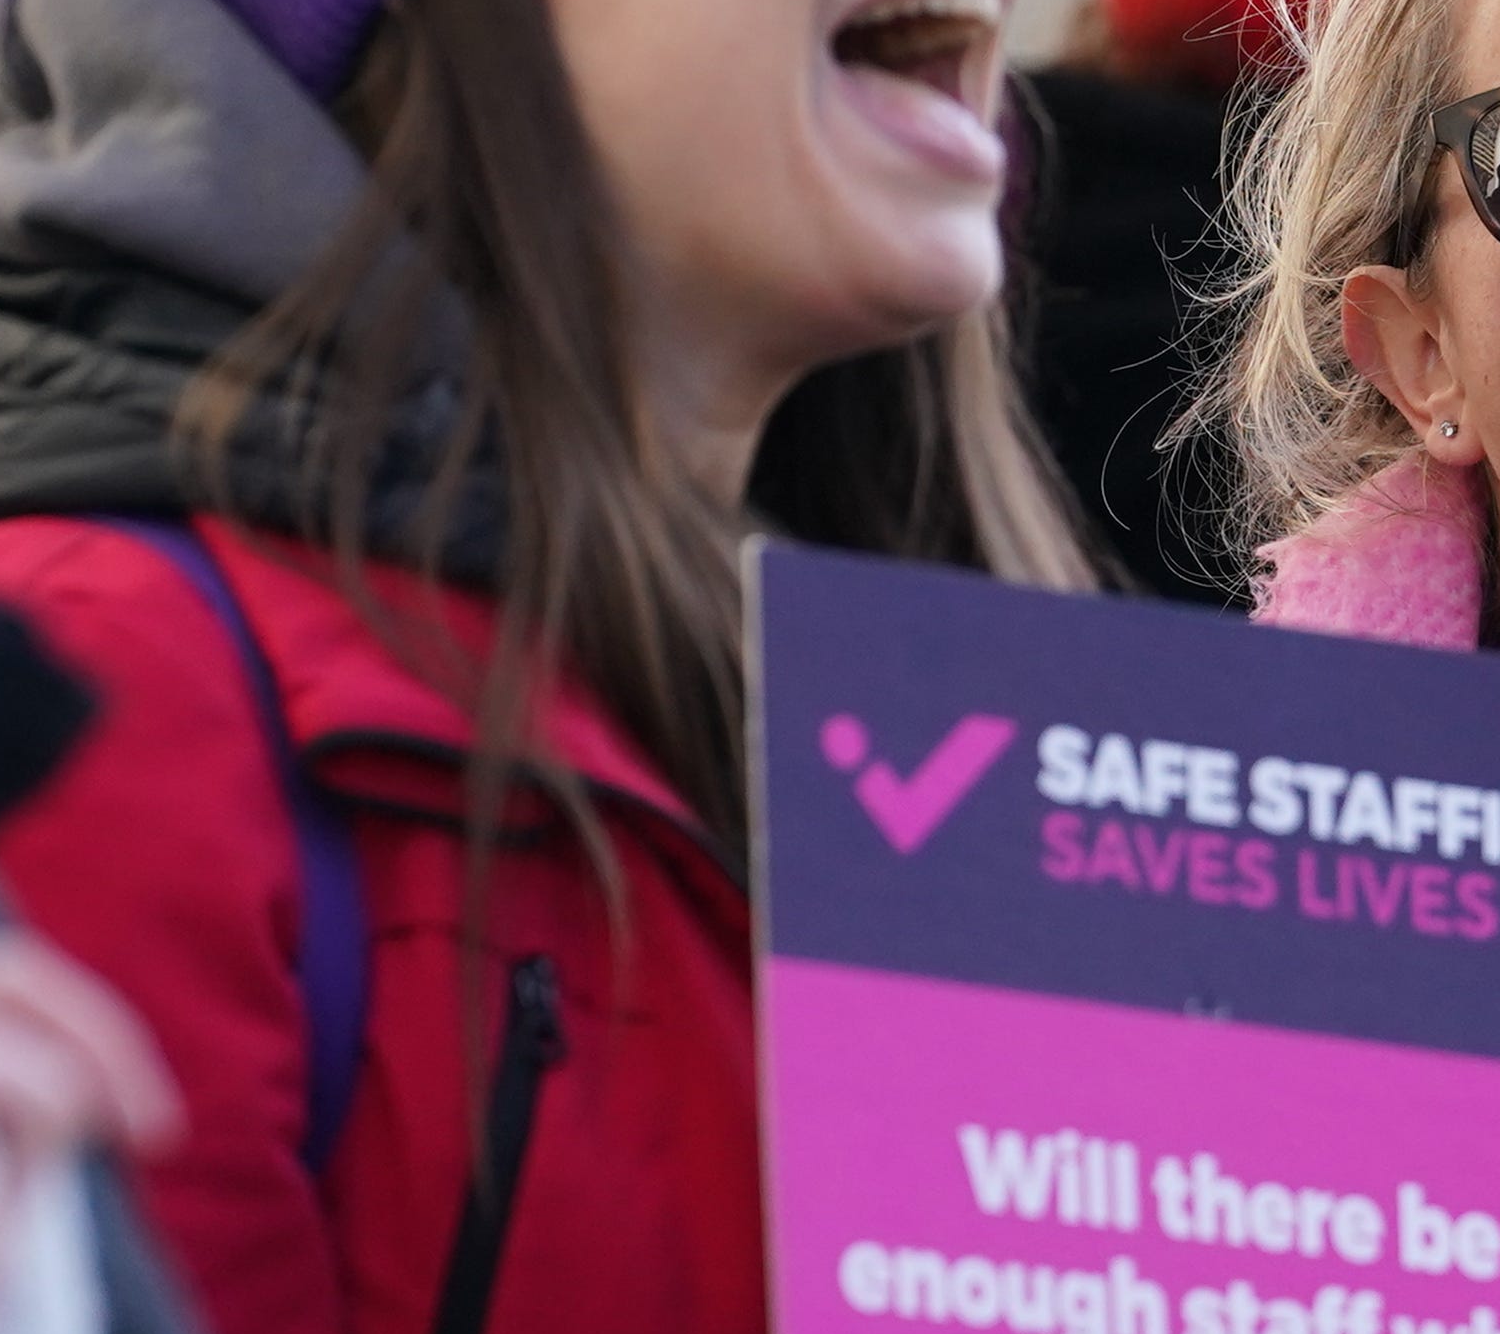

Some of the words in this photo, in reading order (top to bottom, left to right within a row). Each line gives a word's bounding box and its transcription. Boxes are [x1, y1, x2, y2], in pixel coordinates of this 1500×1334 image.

[1037, 725, 1240, 827] SAFE
[1041, 812, 1278, 909] SAVES
[1298, 852, 1499, 941] LIVES
[958, 1123, 1141, 1232] Will
[1151, 1152, 1386, 1264] there
